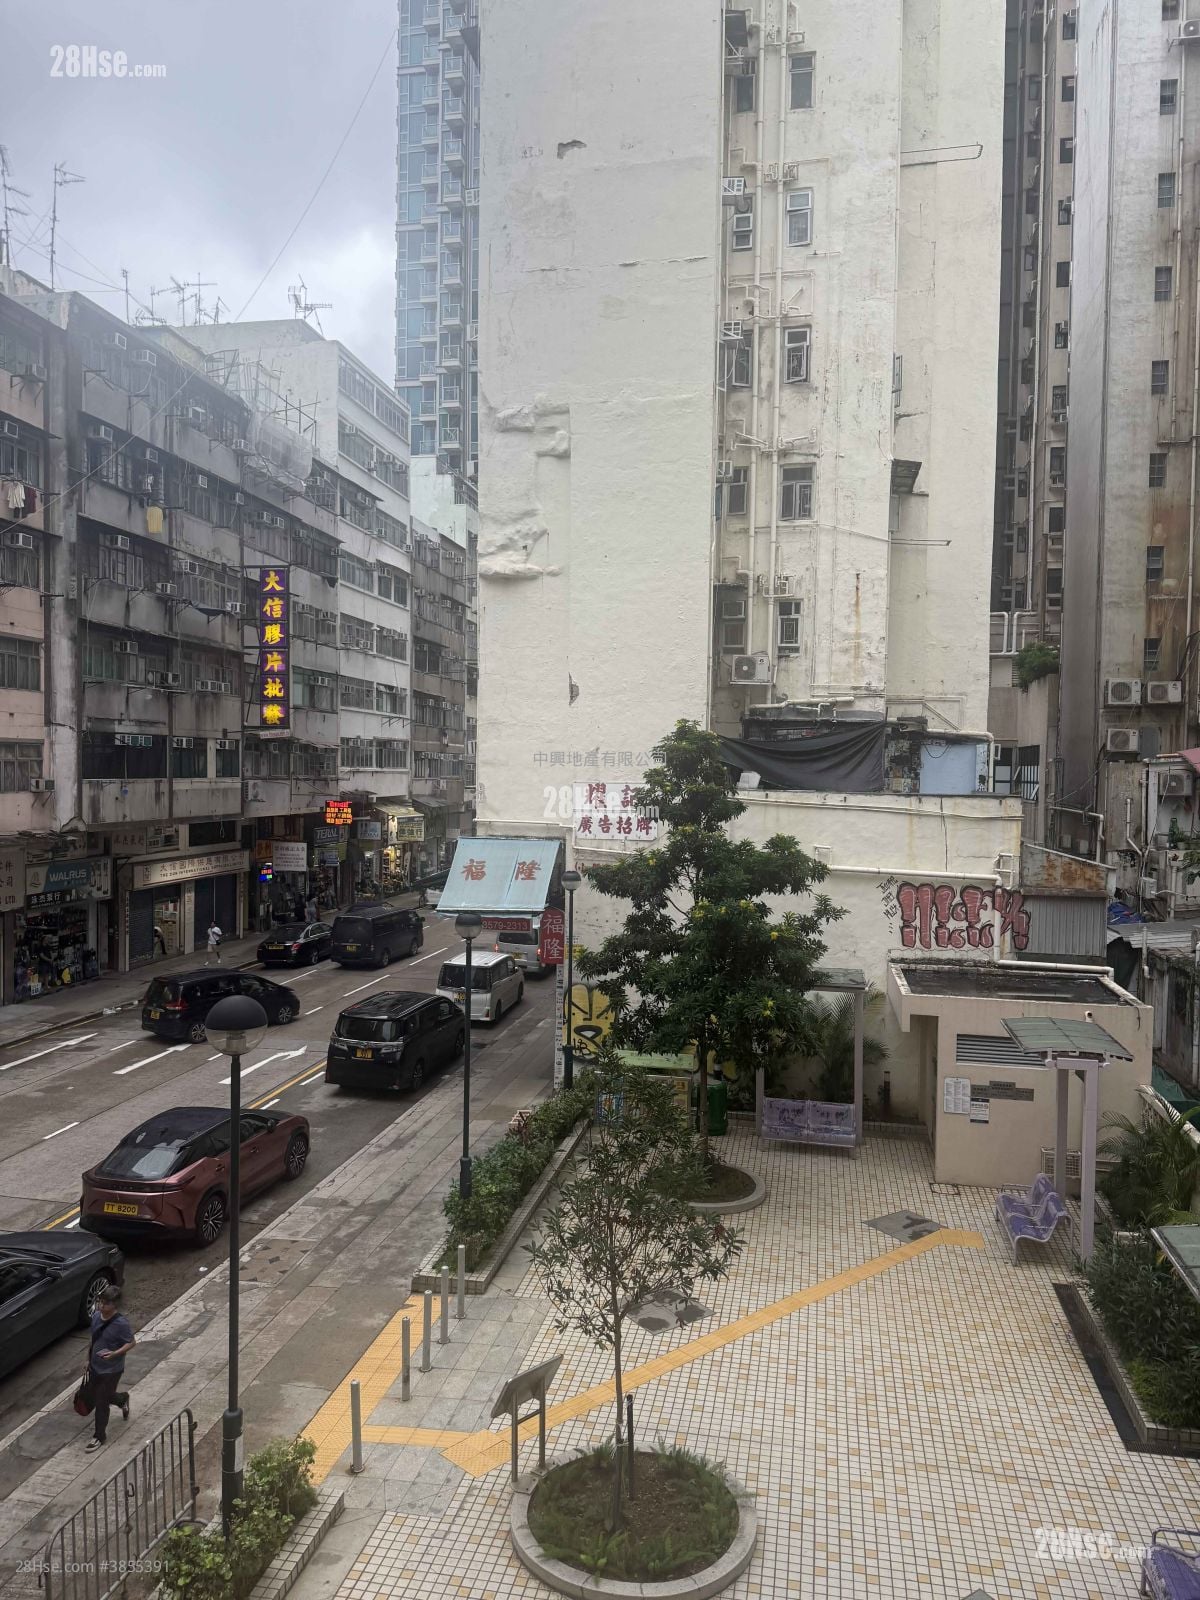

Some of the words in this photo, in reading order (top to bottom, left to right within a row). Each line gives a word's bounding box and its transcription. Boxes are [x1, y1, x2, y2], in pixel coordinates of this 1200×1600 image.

[262, 570, 285, 725] 大信膠片批發
[578, 814, 653, 836] 廣告招牌
[49, 868, 87, 882] WALRUS
[460, 858, 542, 882] 福隆
[543, 914, 564, 960] 福隆
